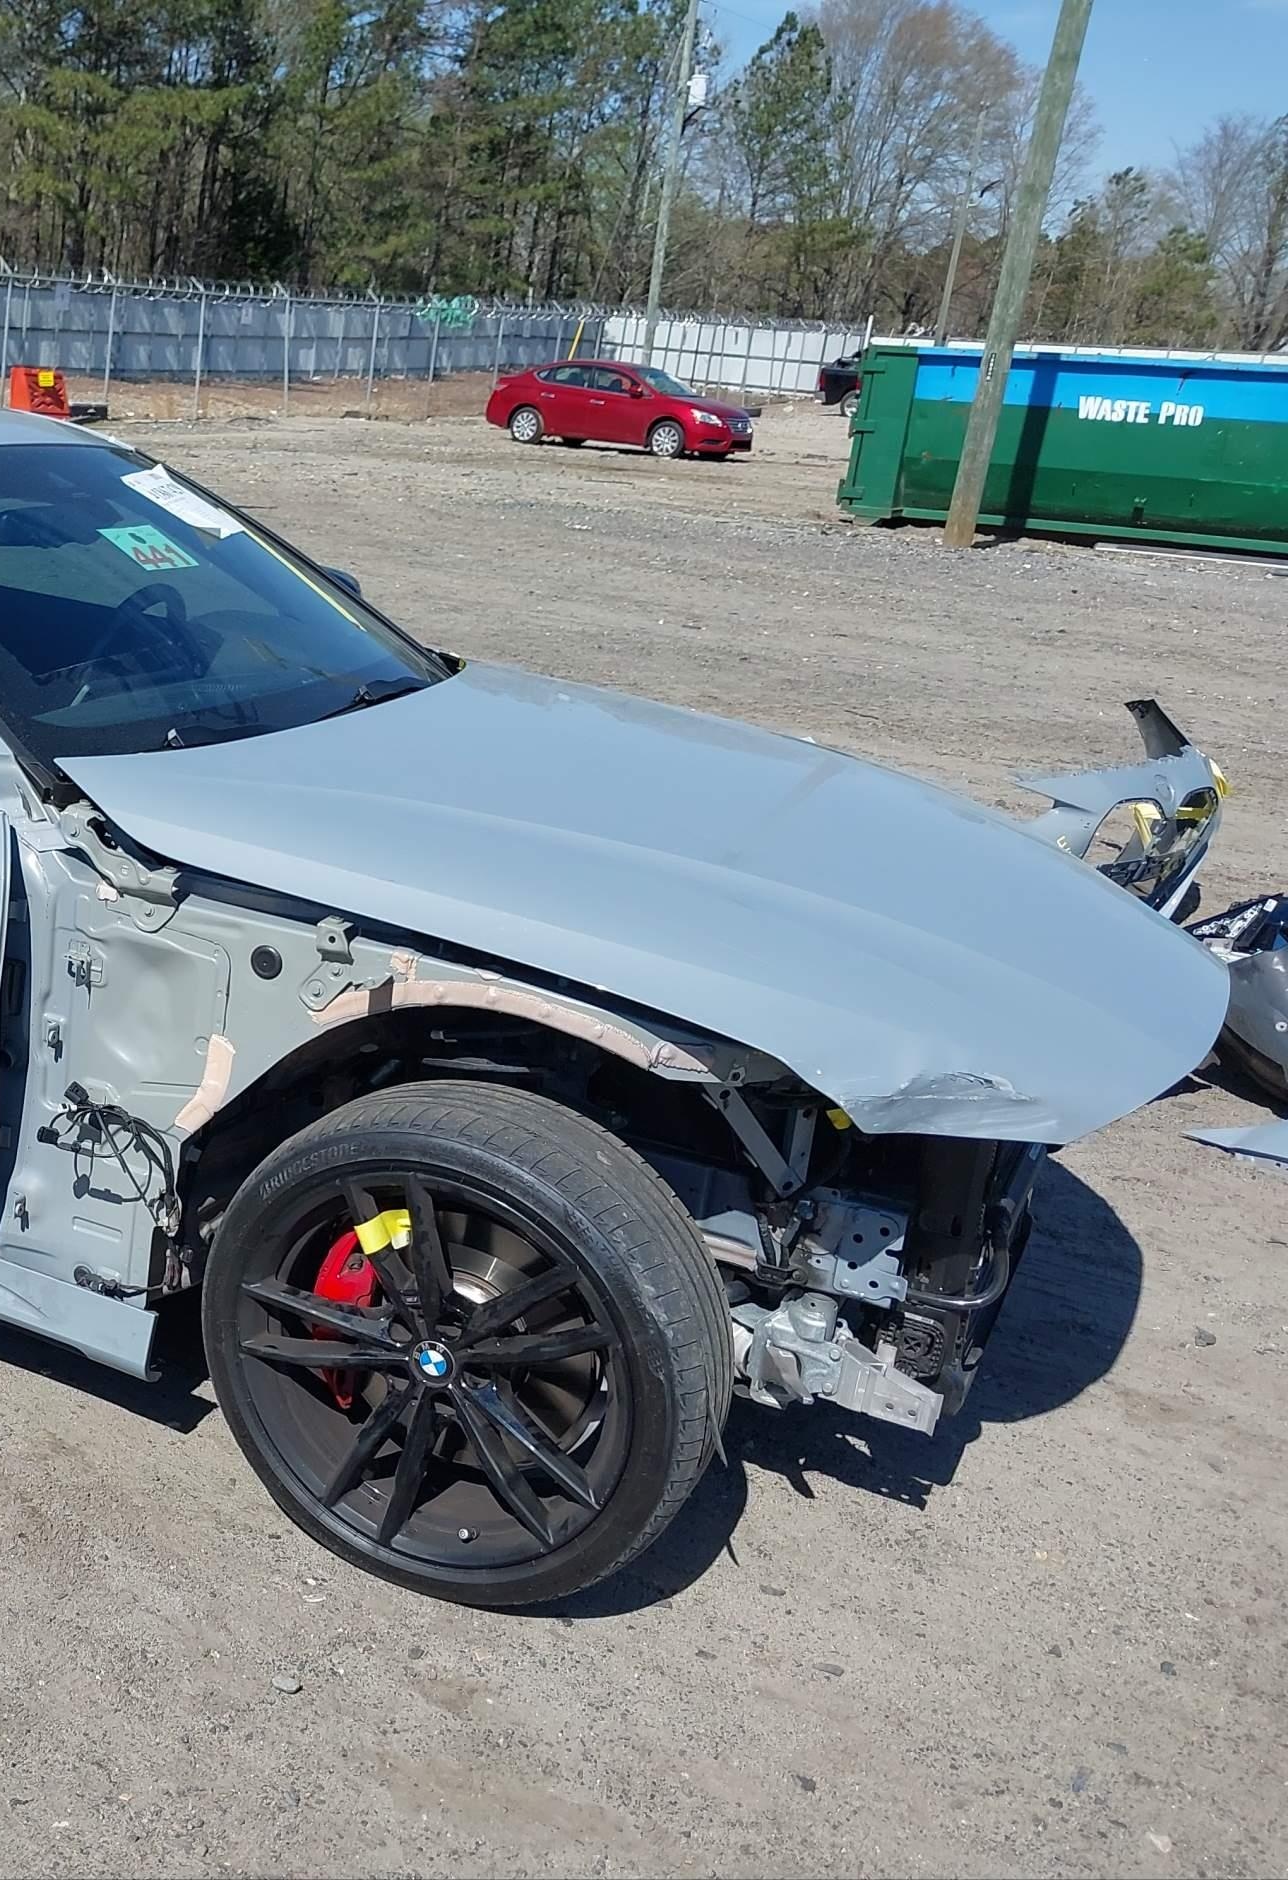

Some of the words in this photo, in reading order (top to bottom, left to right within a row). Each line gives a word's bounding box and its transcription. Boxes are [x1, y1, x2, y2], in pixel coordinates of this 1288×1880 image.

[1078, 395, 1152, 424] WASTE
[1158, 401, 1205, 427] PRO
[132, 543, 192, 568] 441
[414, 1343, 446, 1360] BMW
